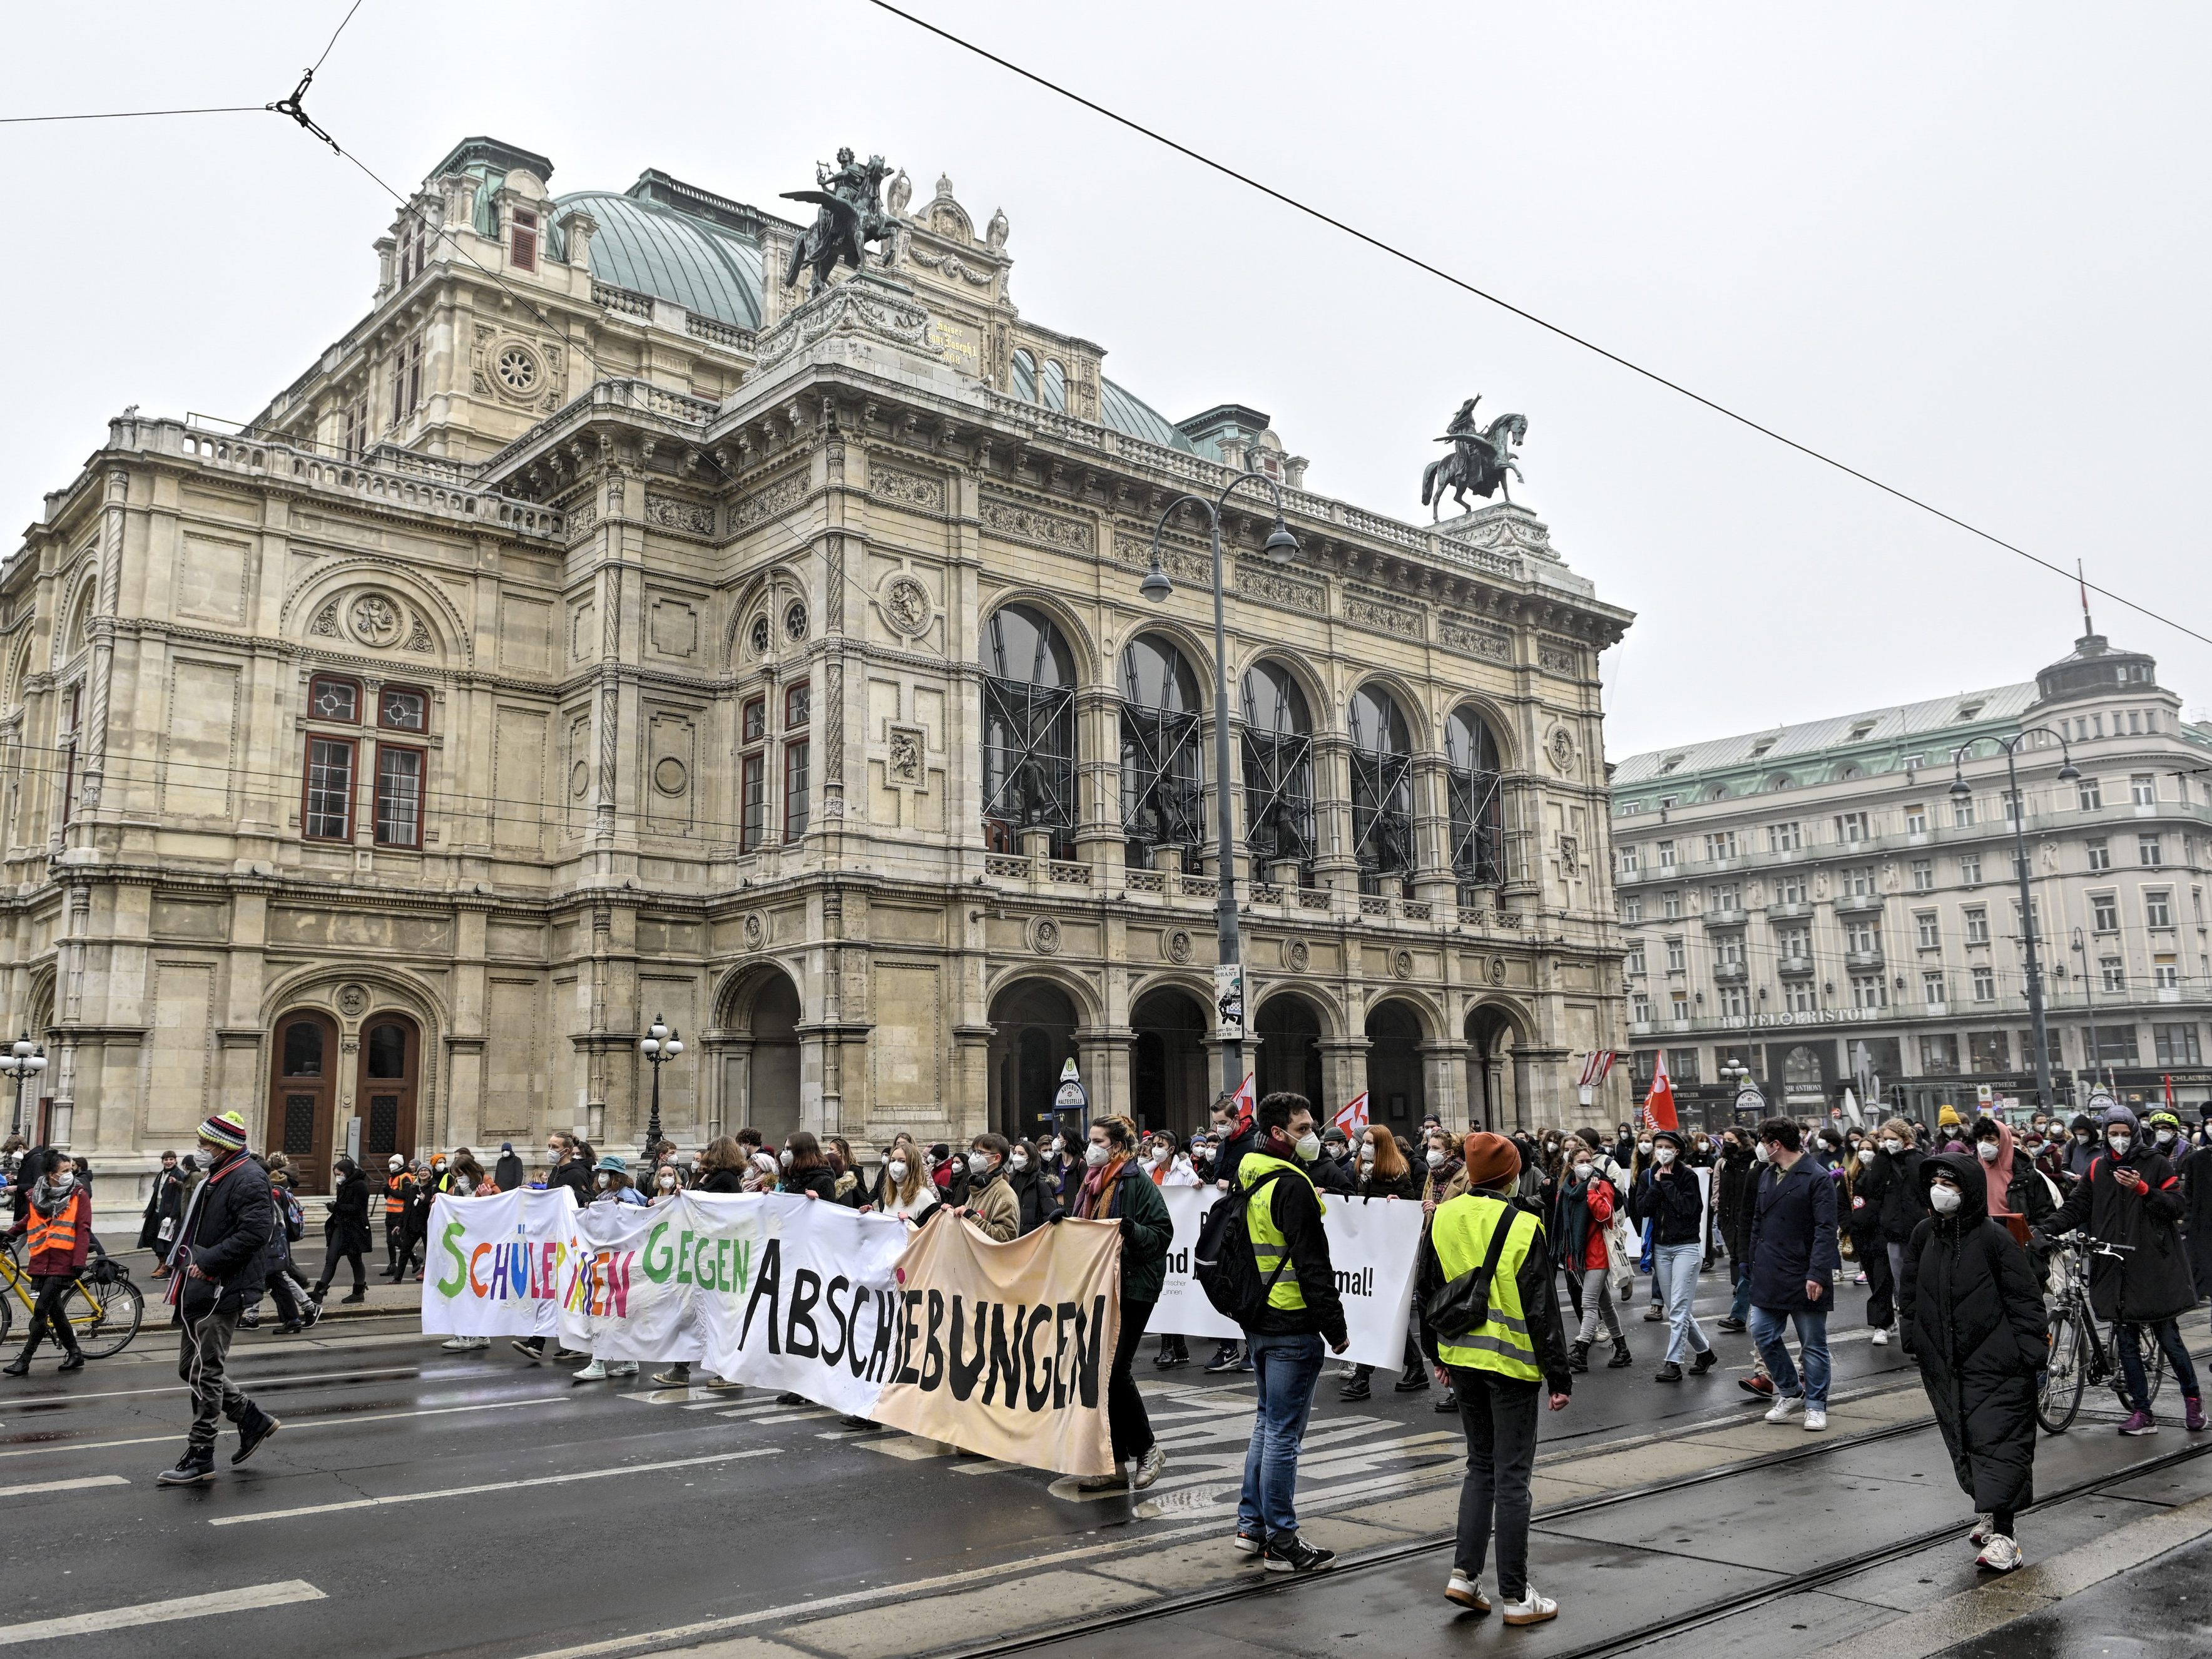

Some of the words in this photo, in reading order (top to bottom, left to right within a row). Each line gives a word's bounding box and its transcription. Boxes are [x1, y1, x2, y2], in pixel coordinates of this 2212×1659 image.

[937, 320, 963, 337] Kaiser
[944, 334, 971, 359] Joseph
[1721, 1012, 1780, 1028] HOTEL
[1795, 1008, 1868, 1024] BRISTOL
[1067, 1061, 1073, 1069] H
[1061, 1085, 1079, 1094] AUTOBUS
[1795, 1084, 1822, 1092] ANTHONY
[642, 1221, 750, 1294] GEGEN
[737, 1238, 1106, 1412] ABSCHIEBUNGEN
